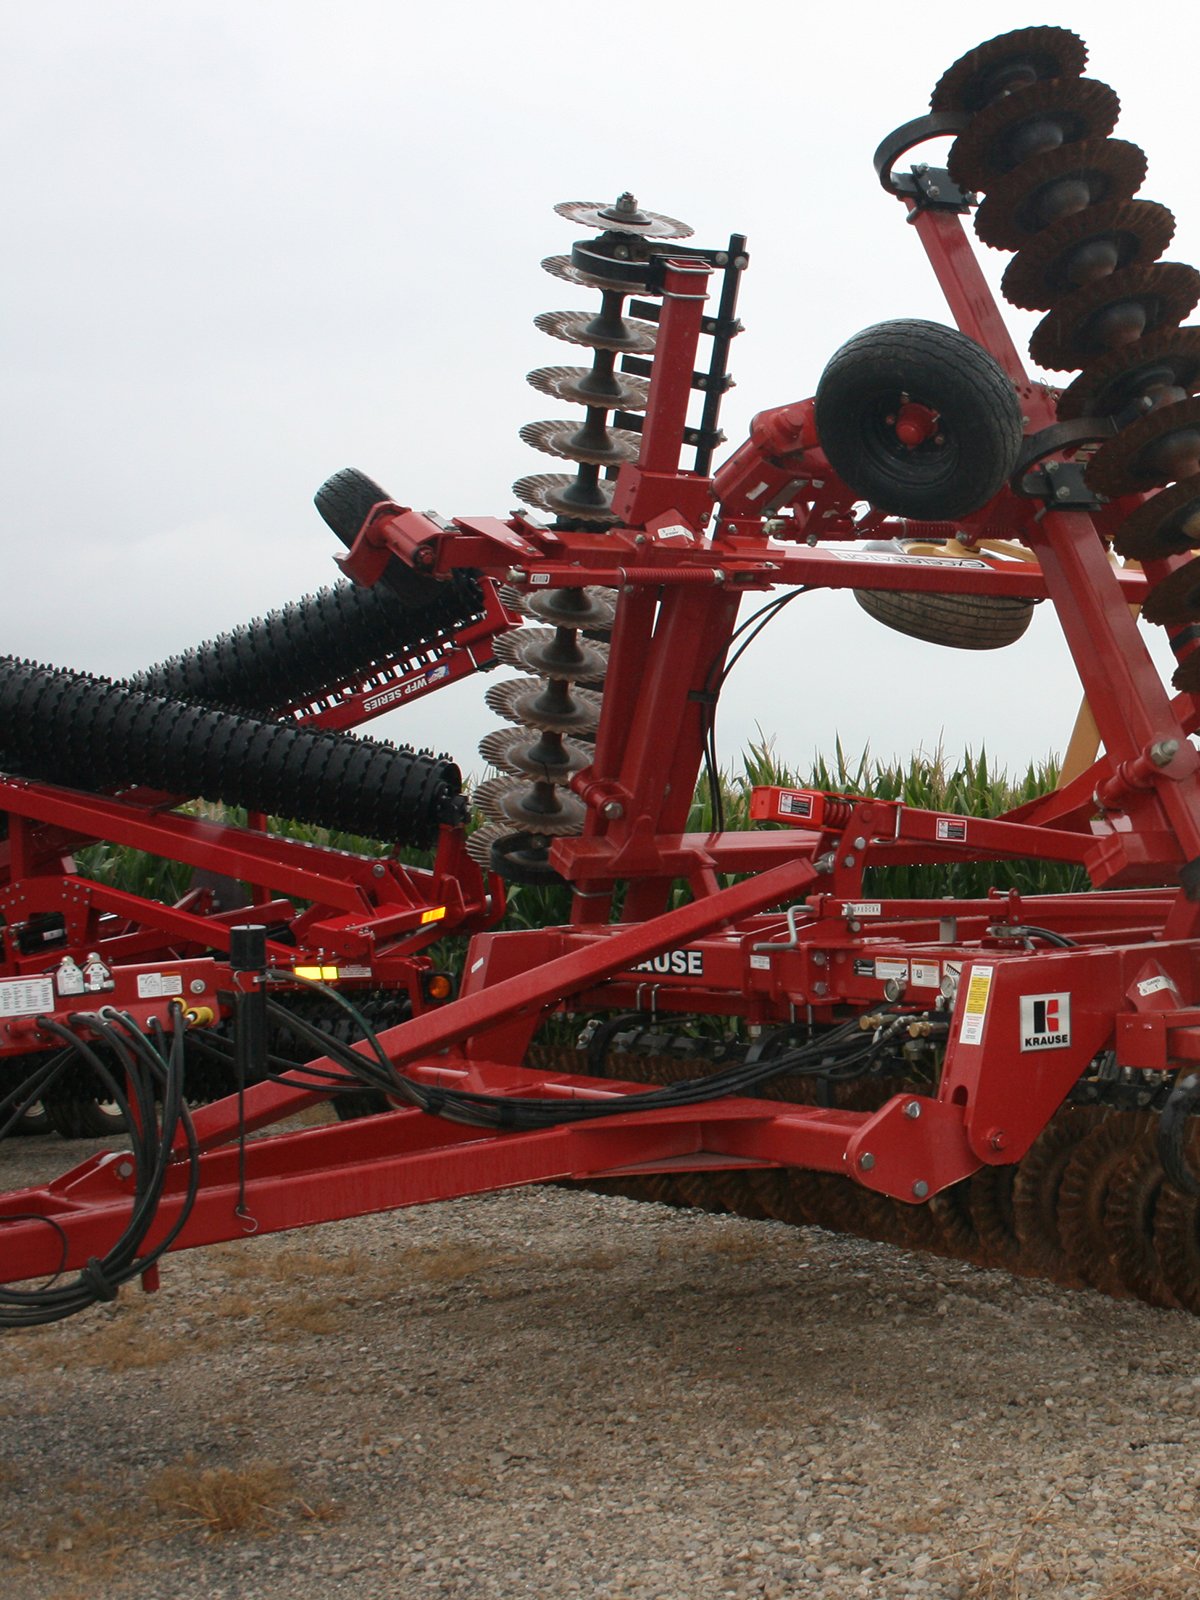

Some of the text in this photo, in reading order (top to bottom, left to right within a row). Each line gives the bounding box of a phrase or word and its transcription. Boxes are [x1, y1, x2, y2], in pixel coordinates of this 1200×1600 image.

[363, 677, 428, 712] WFP SERIES
[629, 950, 703, 974] AUSE
[1024, 1034, 1068, 1047] KRAUSE
